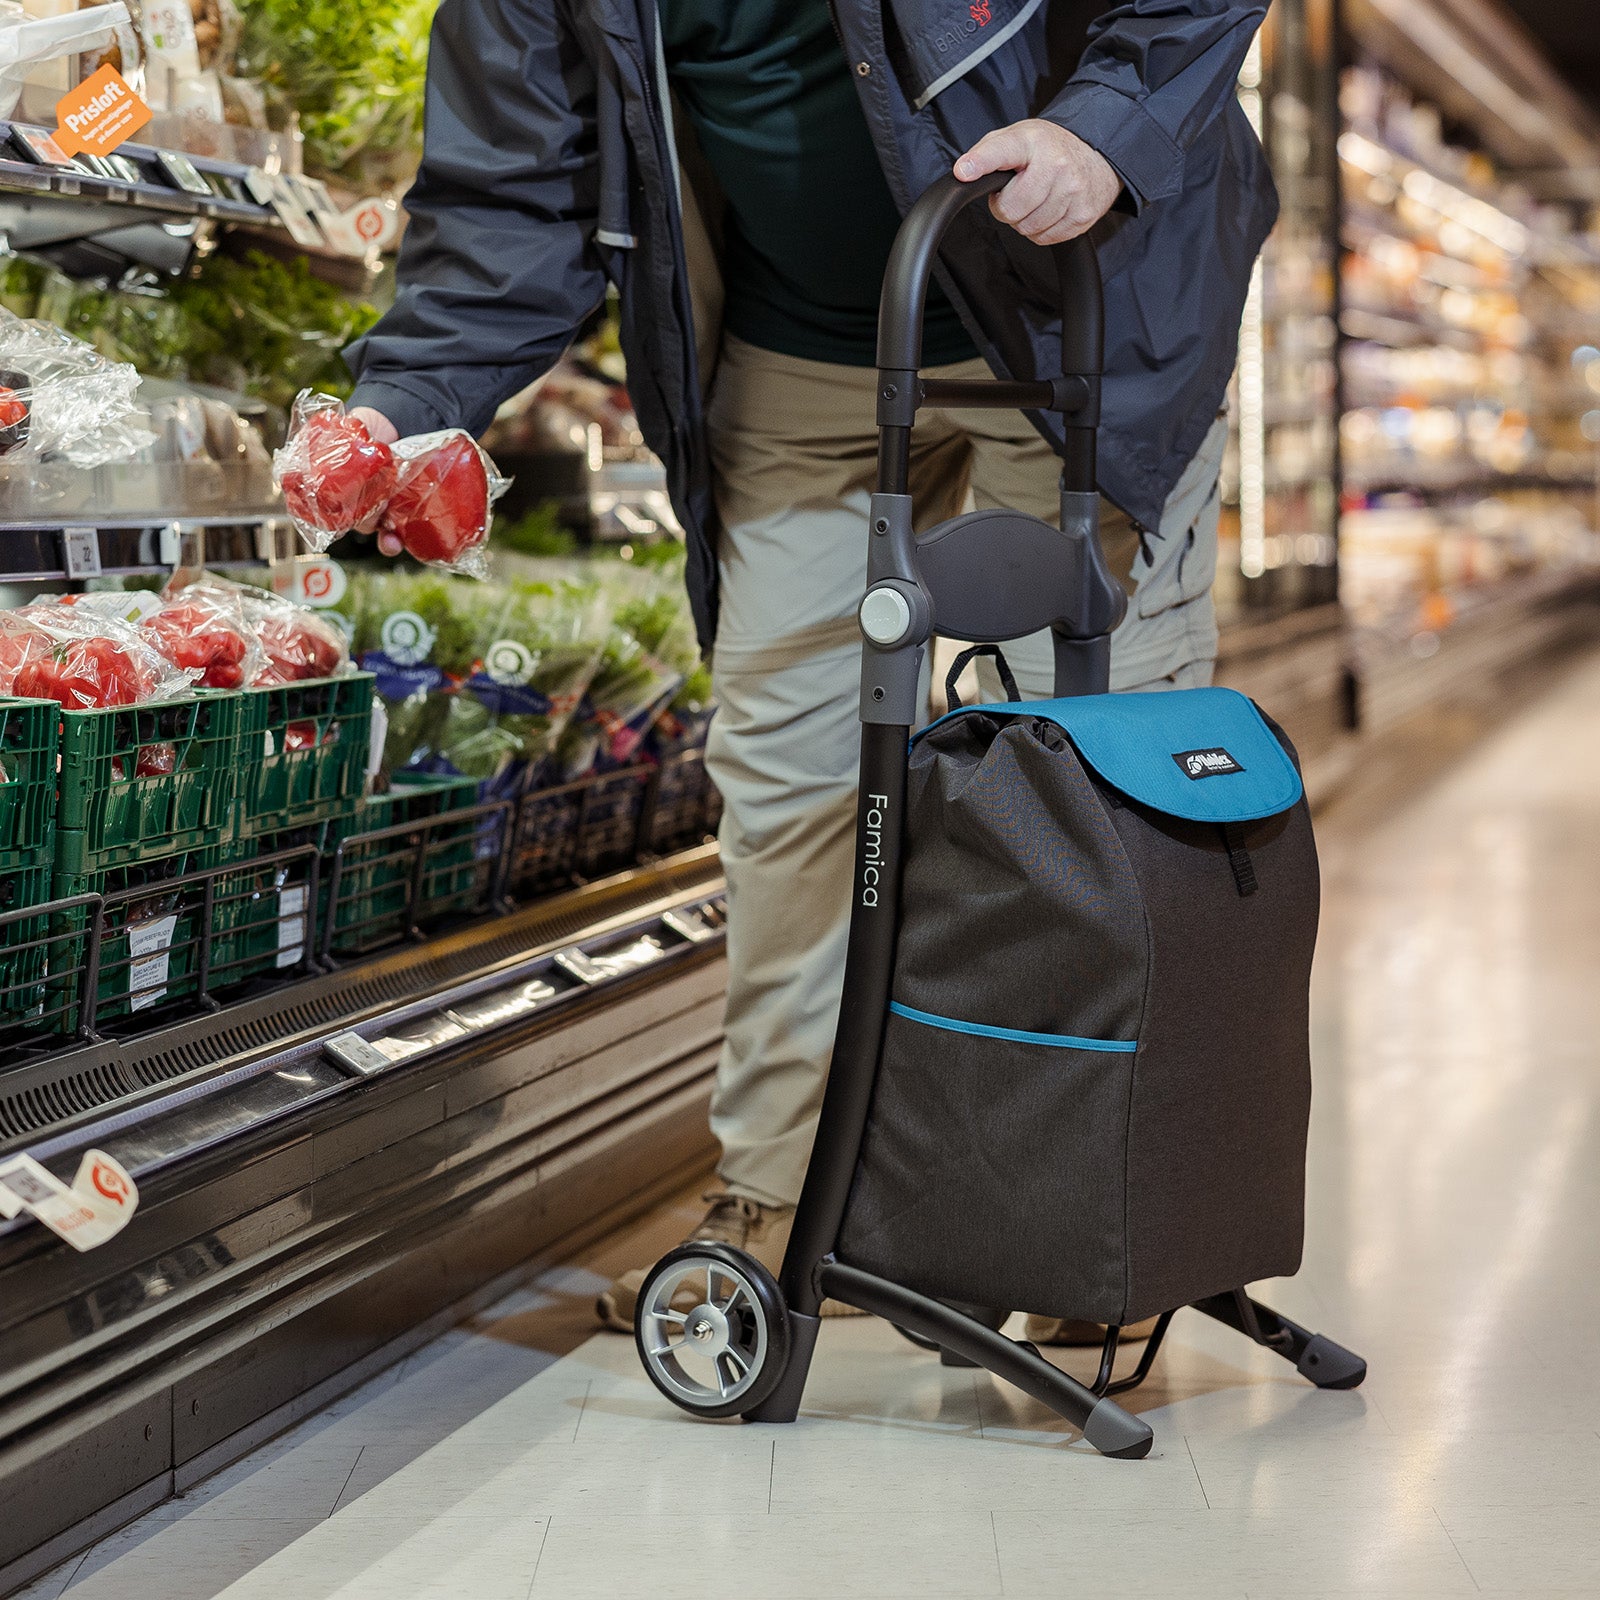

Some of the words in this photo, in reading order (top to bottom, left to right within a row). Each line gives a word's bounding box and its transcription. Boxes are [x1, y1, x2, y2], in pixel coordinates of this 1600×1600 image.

[934, 19, 977, 53] BAILO
[63, 81, 126, 134] Prisloft
[862, 794, 888, 907] Famica
